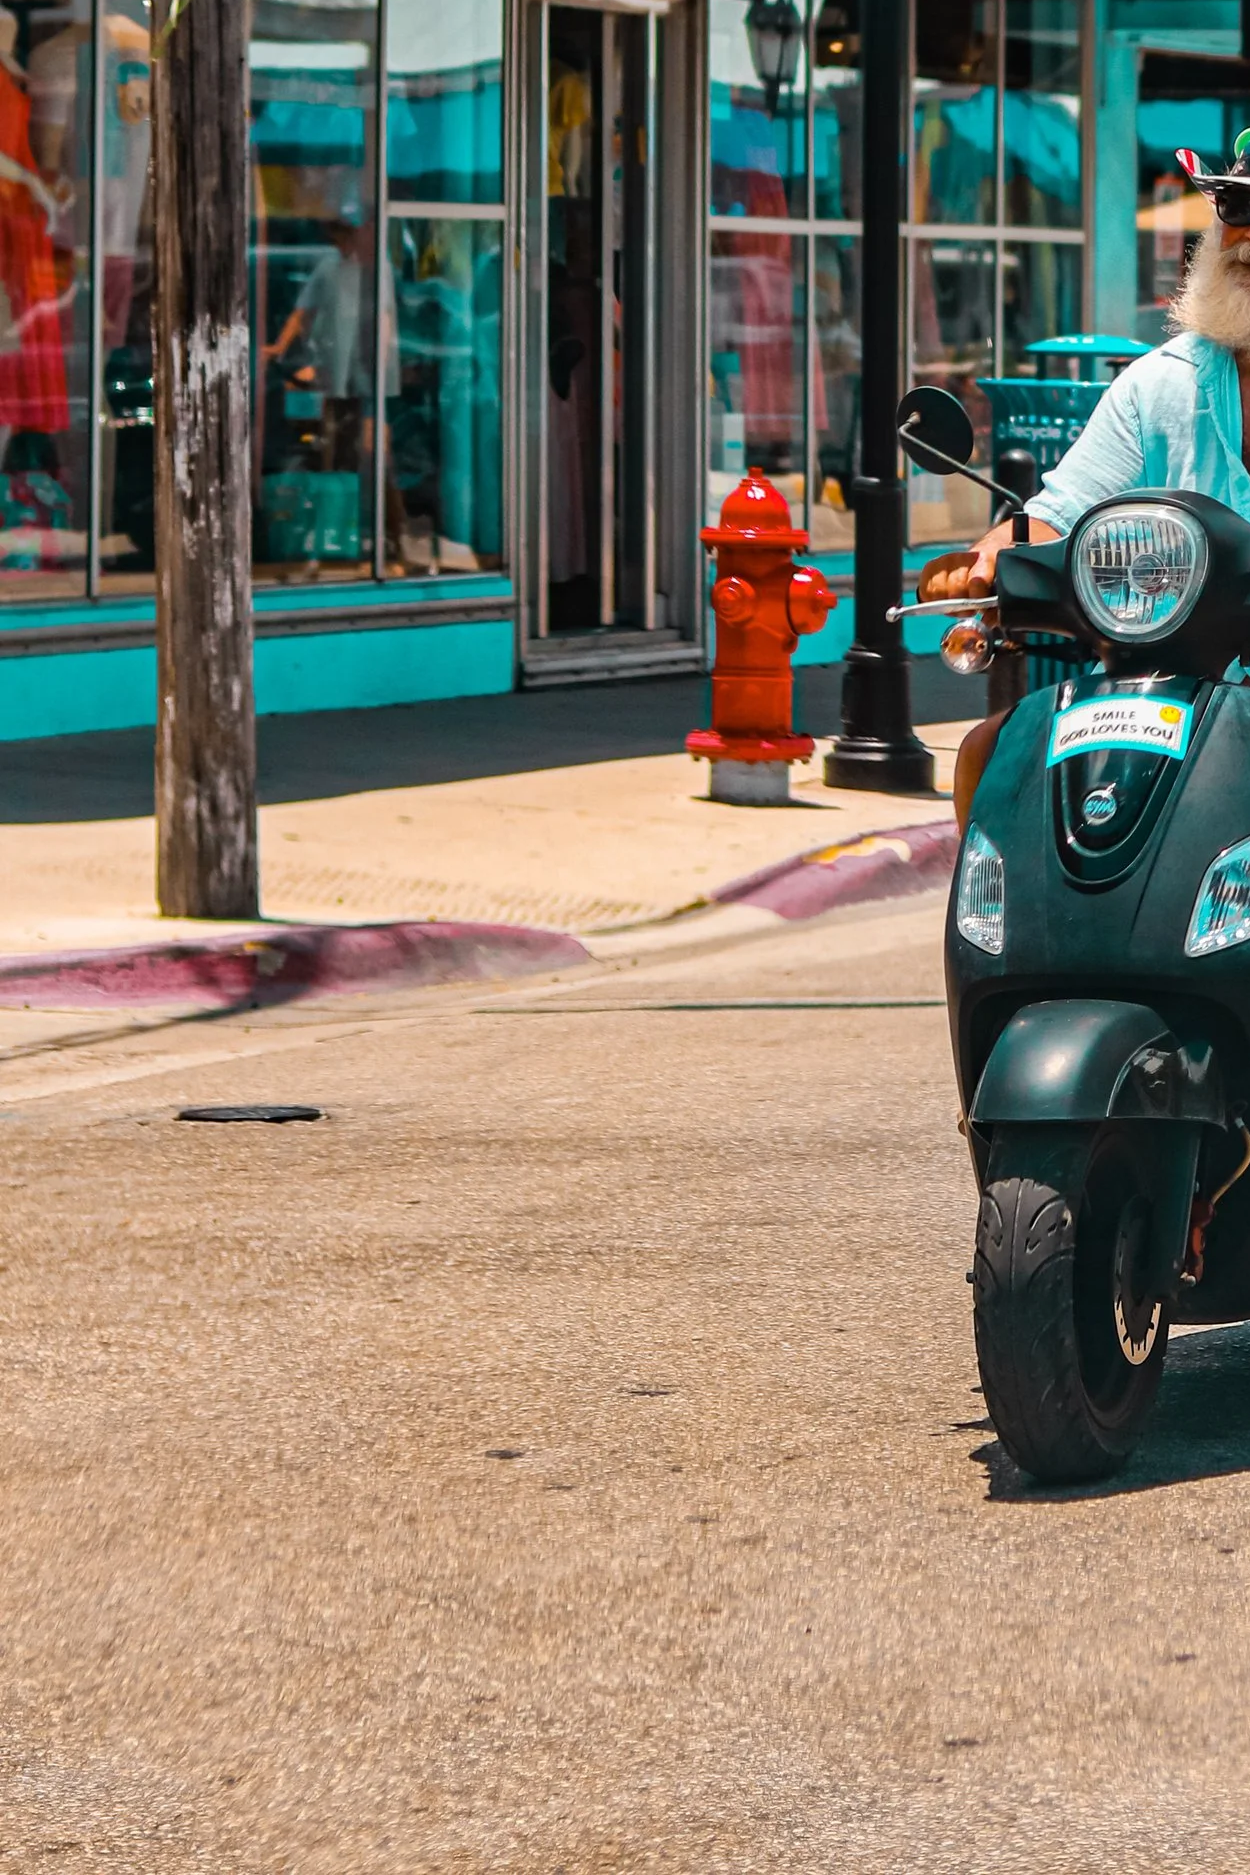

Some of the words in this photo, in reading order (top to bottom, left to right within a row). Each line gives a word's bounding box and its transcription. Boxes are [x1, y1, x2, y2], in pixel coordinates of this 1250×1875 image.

[1093, 711, 1136, 722] SMILE
[1060, 727, 1088, 746] GOD
[1091, 724, 1137, 737] LOVES
[1141, 726, 1173, 740] YOU
